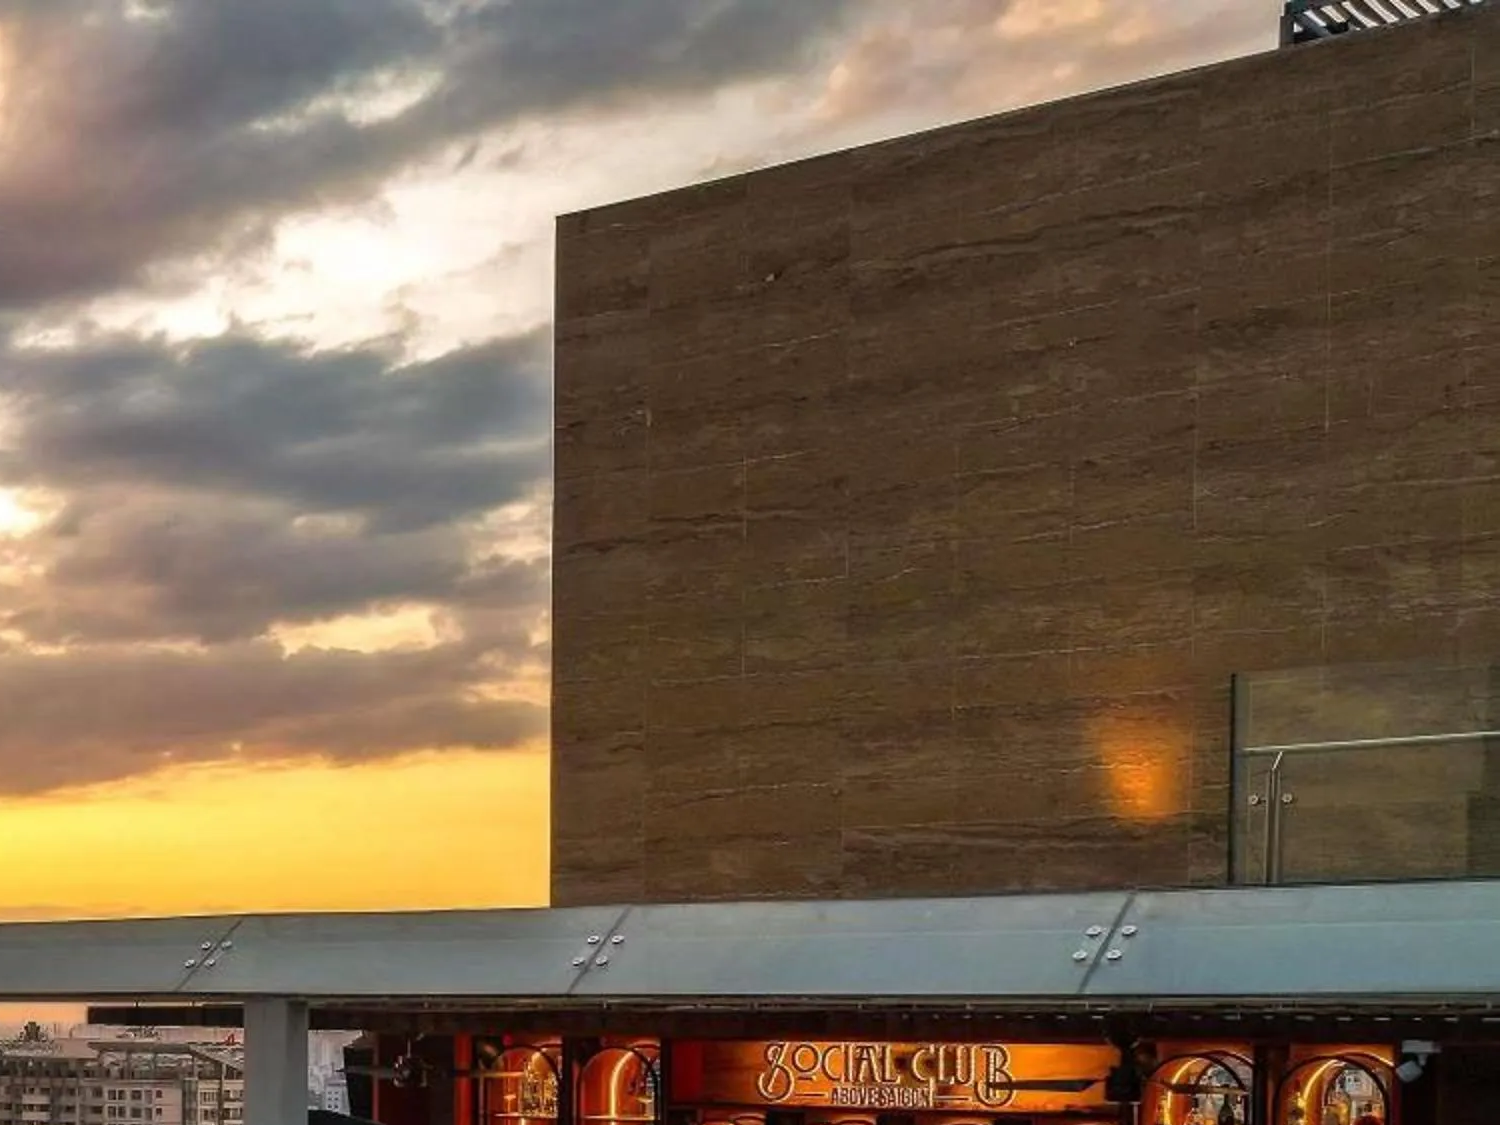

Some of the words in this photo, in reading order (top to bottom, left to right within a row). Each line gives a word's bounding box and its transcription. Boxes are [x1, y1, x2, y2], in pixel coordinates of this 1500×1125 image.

[757, 1041, 901, 1102] SOCIAL
[911, 1043, 1015, 1107] CLUB
[831, 1087, 876, 1105] ABOVE
[877, 1087, 934, 1109] SAIGON
